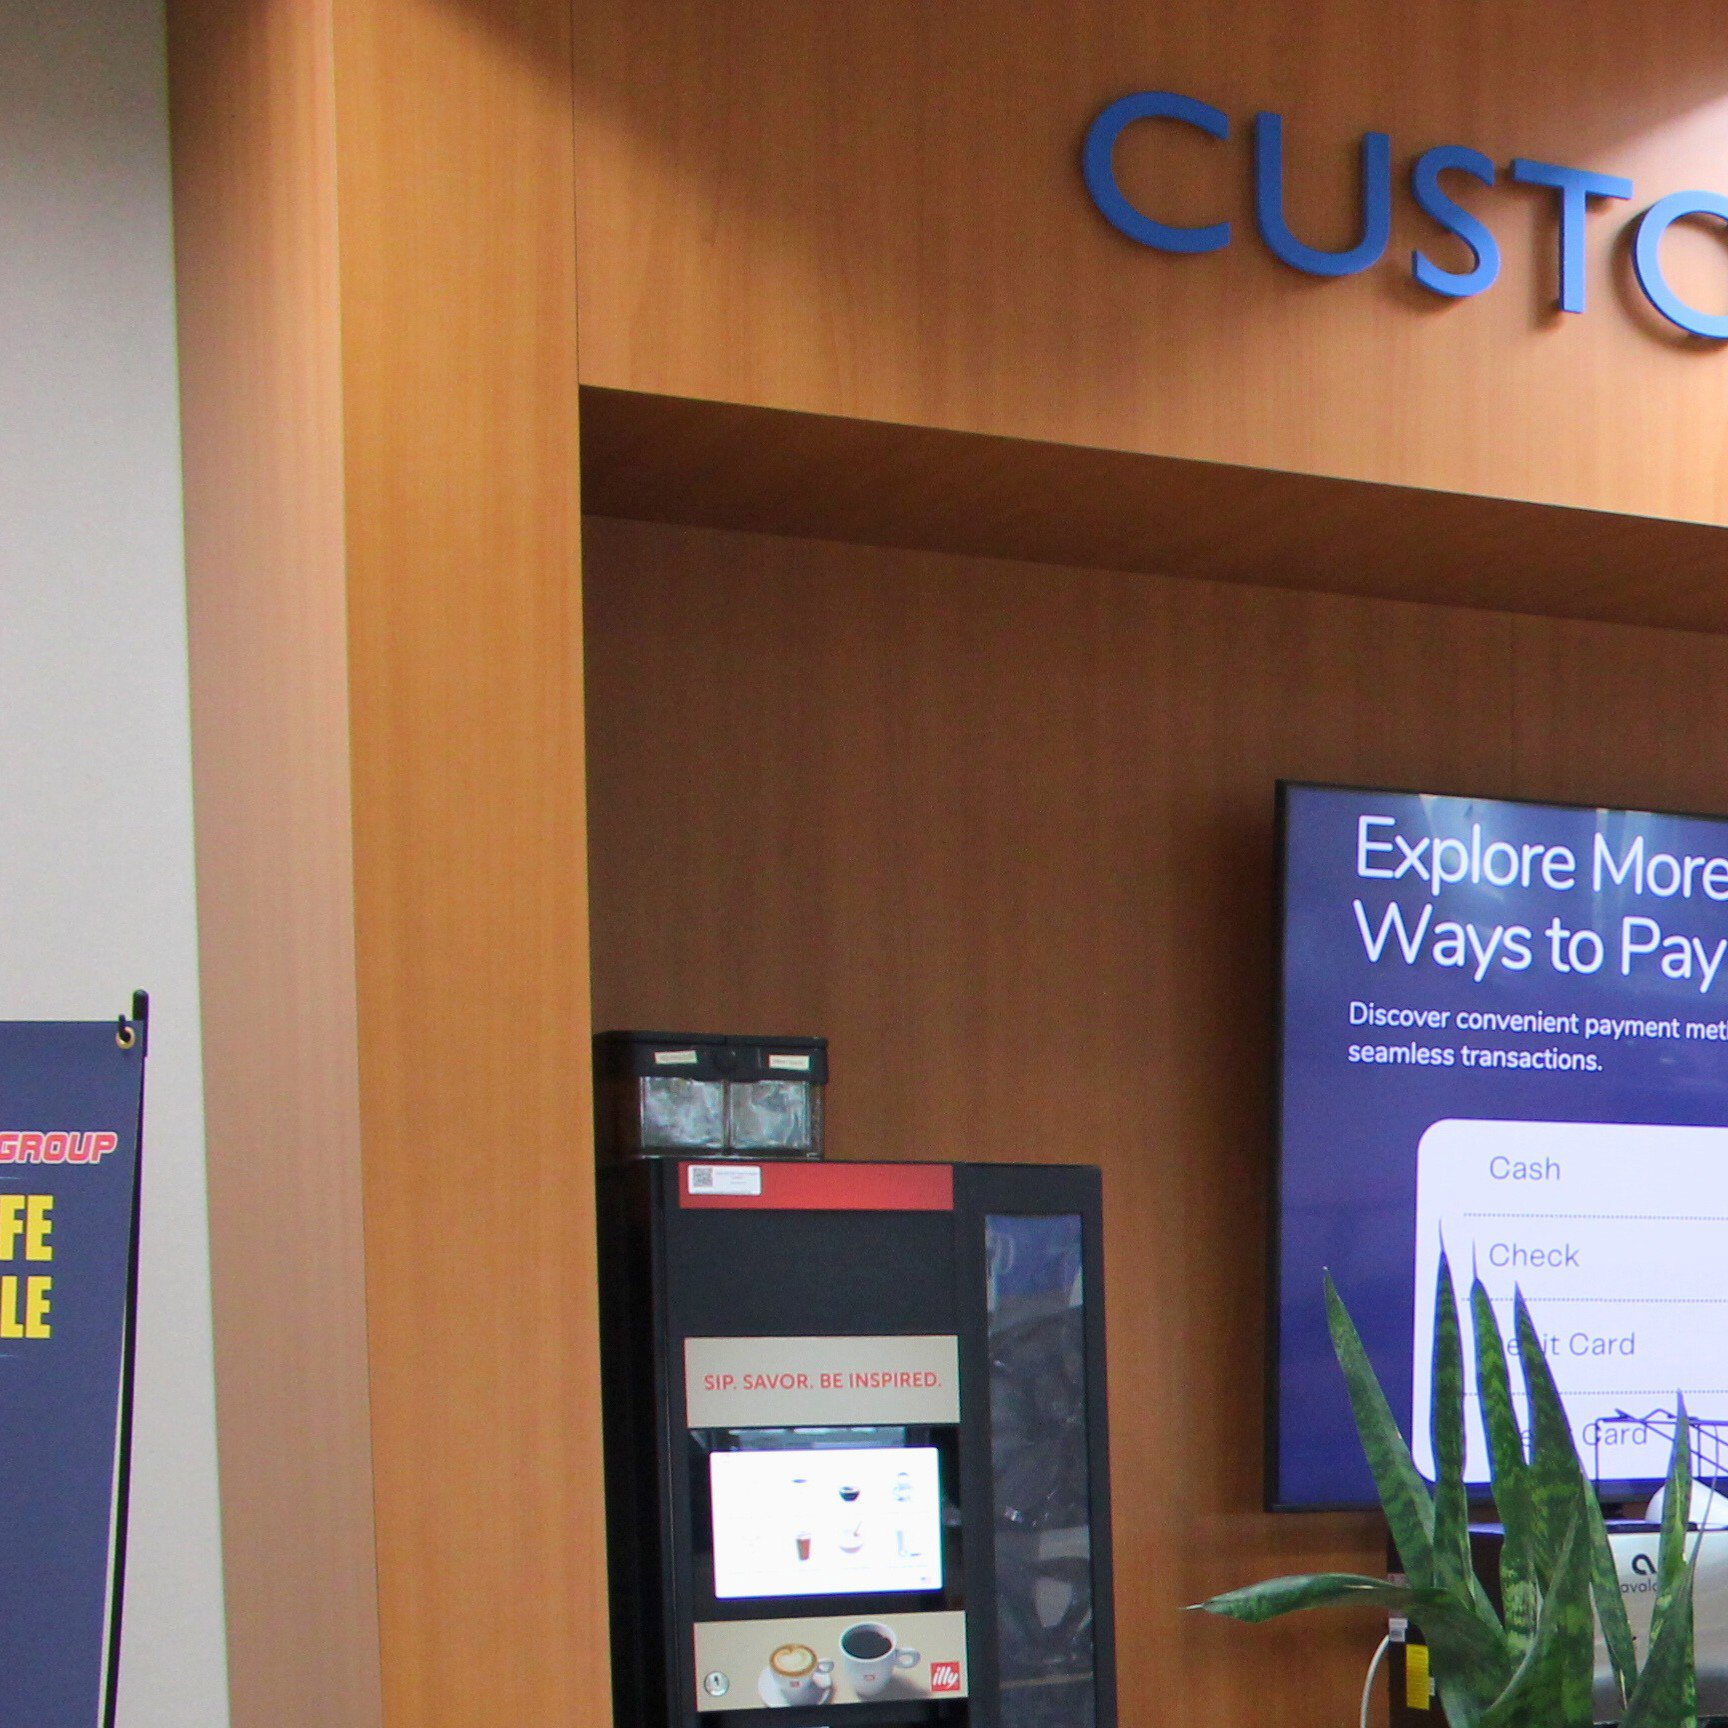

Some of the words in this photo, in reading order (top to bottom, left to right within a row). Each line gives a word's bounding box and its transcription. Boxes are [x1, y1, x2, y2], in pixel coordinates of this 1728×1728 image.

[1358, 815, 1575, 896] Explore
[1353, 899, 1533, 982] Ways
[1546, 917, 1603, 974] to
[1621, 916, 1728, 993] Pay
[1349, 1001, 1450, 1028] Discover
[1456, 1009, 1579, 1035] convenient
[1585, 1016, 1680, 1039] payment
[1348, 1041, 1454, 1065] seamless
[1462, 1045, 1603, 1071] transactions.
[0, 1132, 117, 1163] GROUP
[1489, 1156, 1562, 1181] Cash
[1488, 1243, 1580, 1268] Check
[1569, 1332, 1636, 1355] Card
[704, 1374, 736, 1391] SIP.
[743, 1373, 814, 1390] SAVOR.
[820, 1373, 843, 1389] BE
[849, 1371, 943, 1388] INSPIRED.
[1582, 1423, 1647, 1446] Card
[933, 1666, 959, 1689] illy
